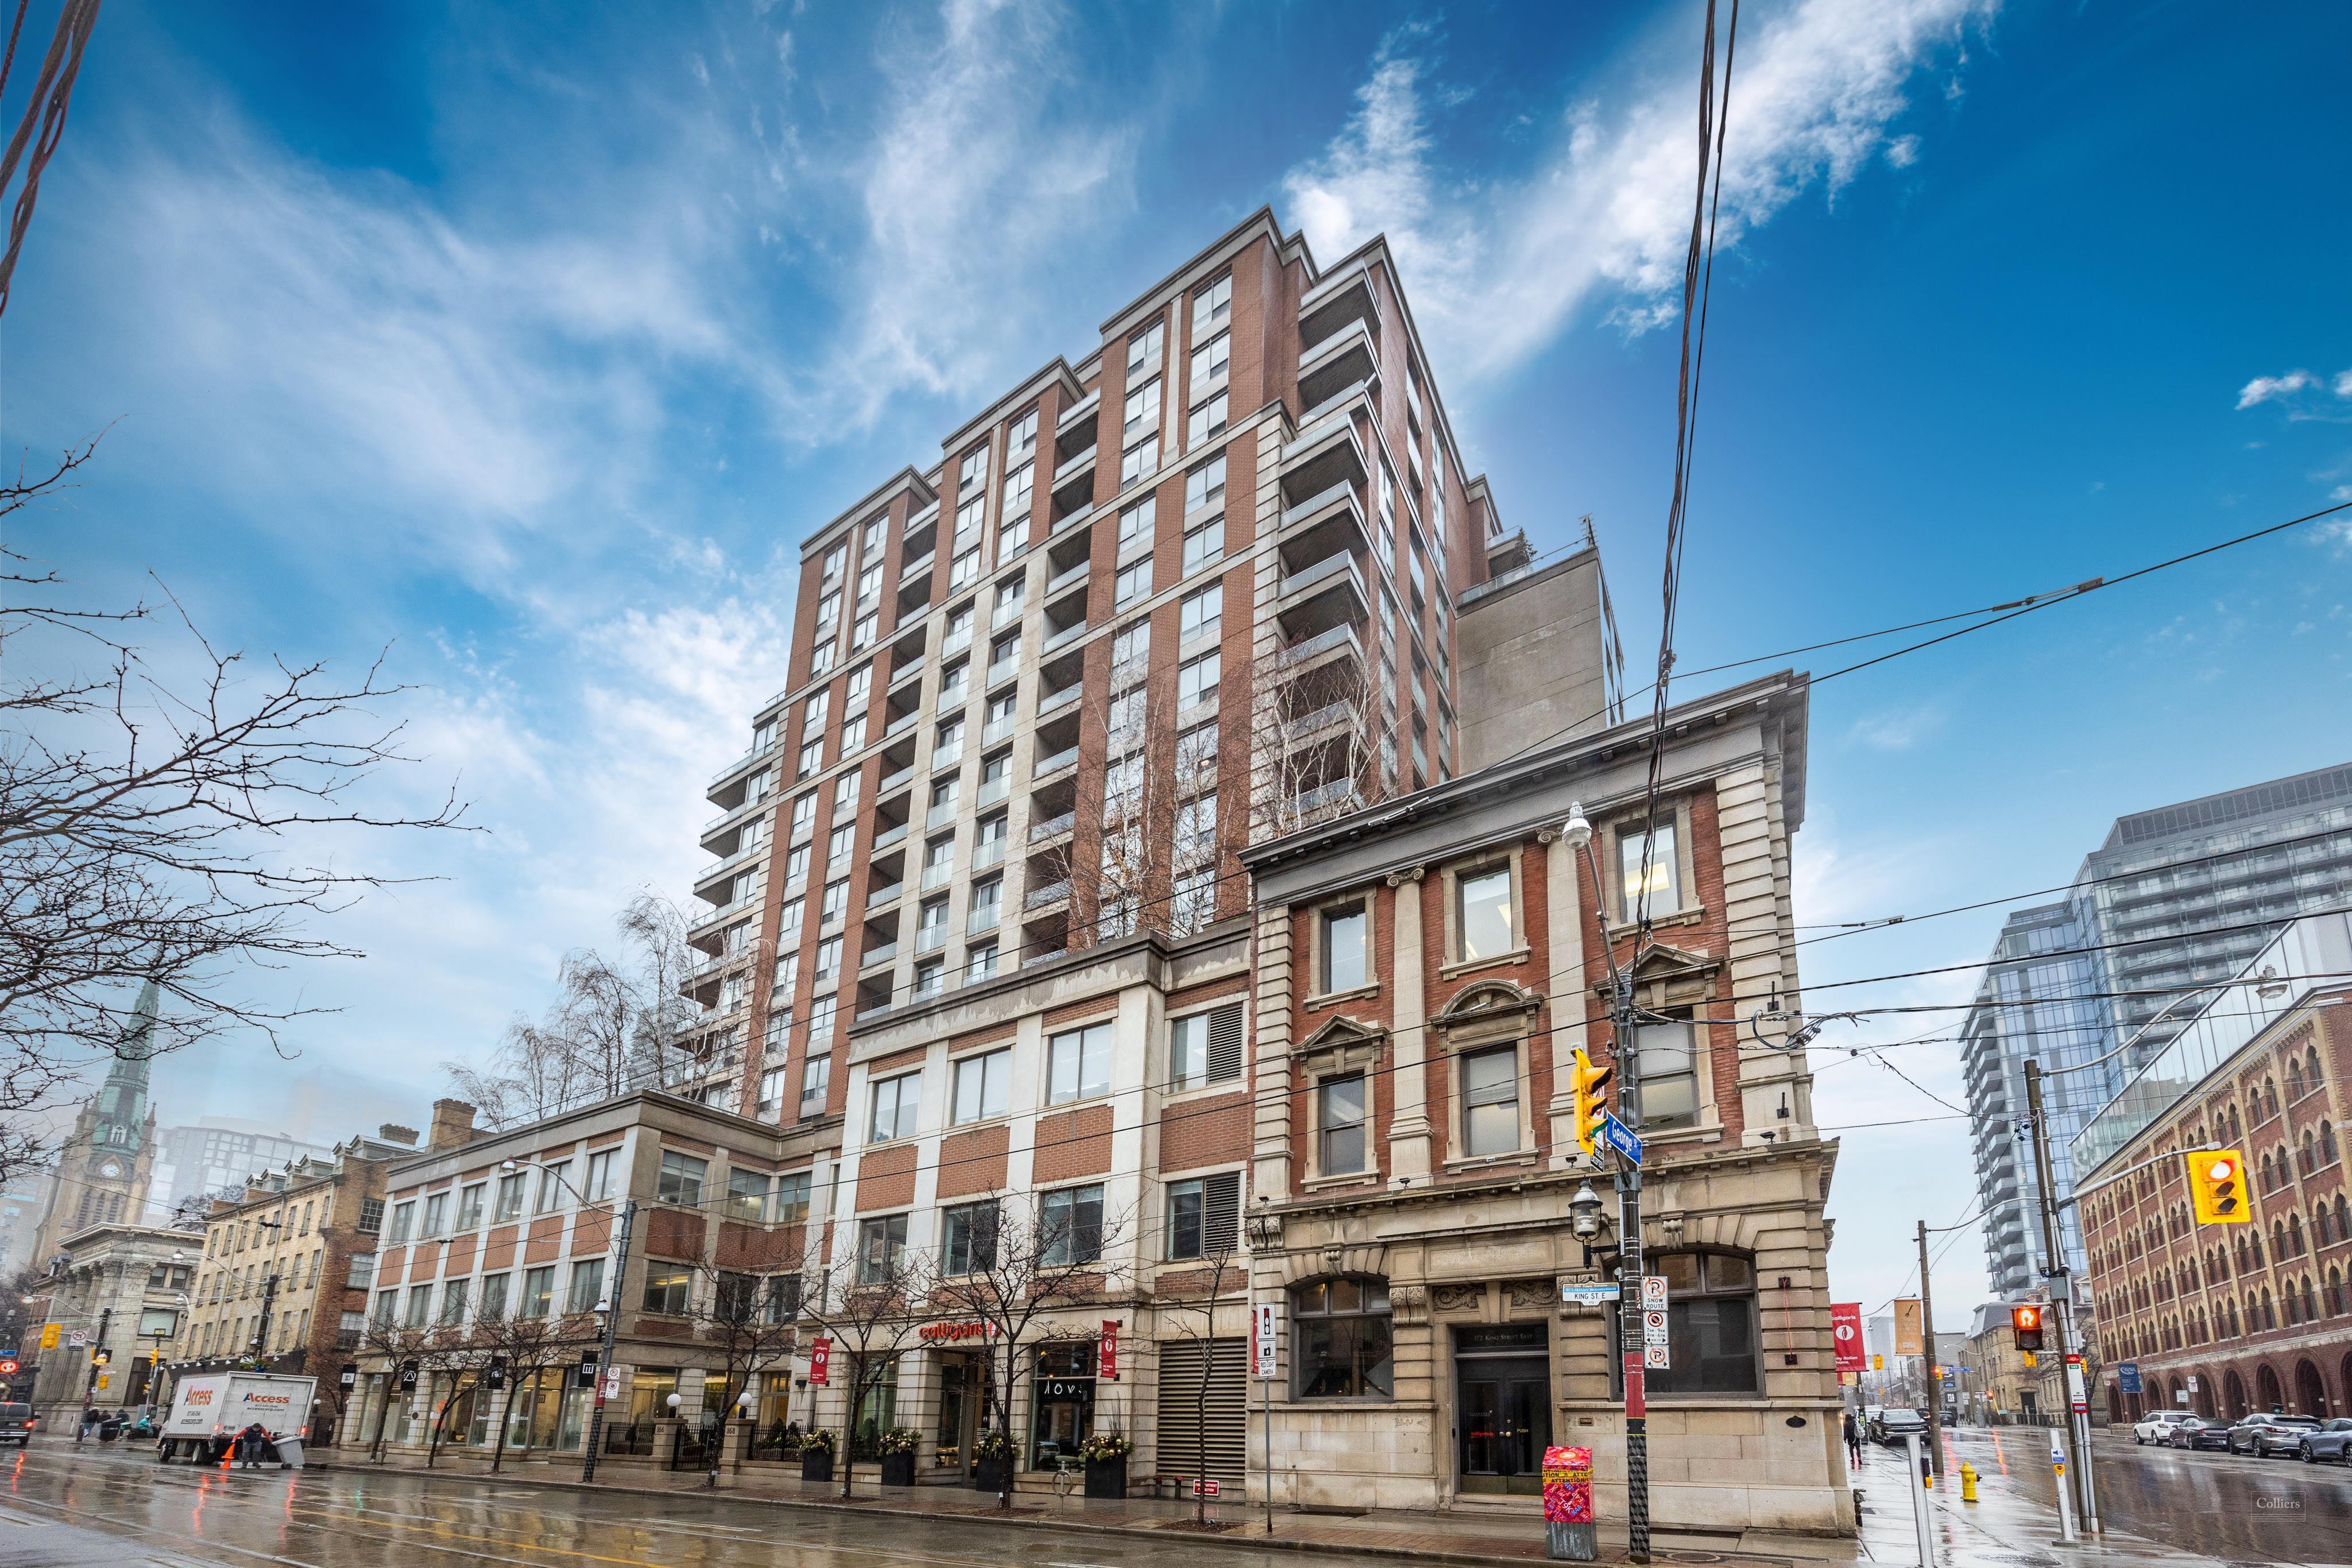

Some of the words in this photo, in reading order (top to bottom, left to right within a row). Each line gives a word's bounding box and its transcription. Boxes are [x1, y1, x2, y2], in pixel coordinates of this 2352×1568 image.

[1612, 1121, 1632, 1153] George
[184, 1385, 214, 1406] Access
[243, 1392, 290, 1405] Access
